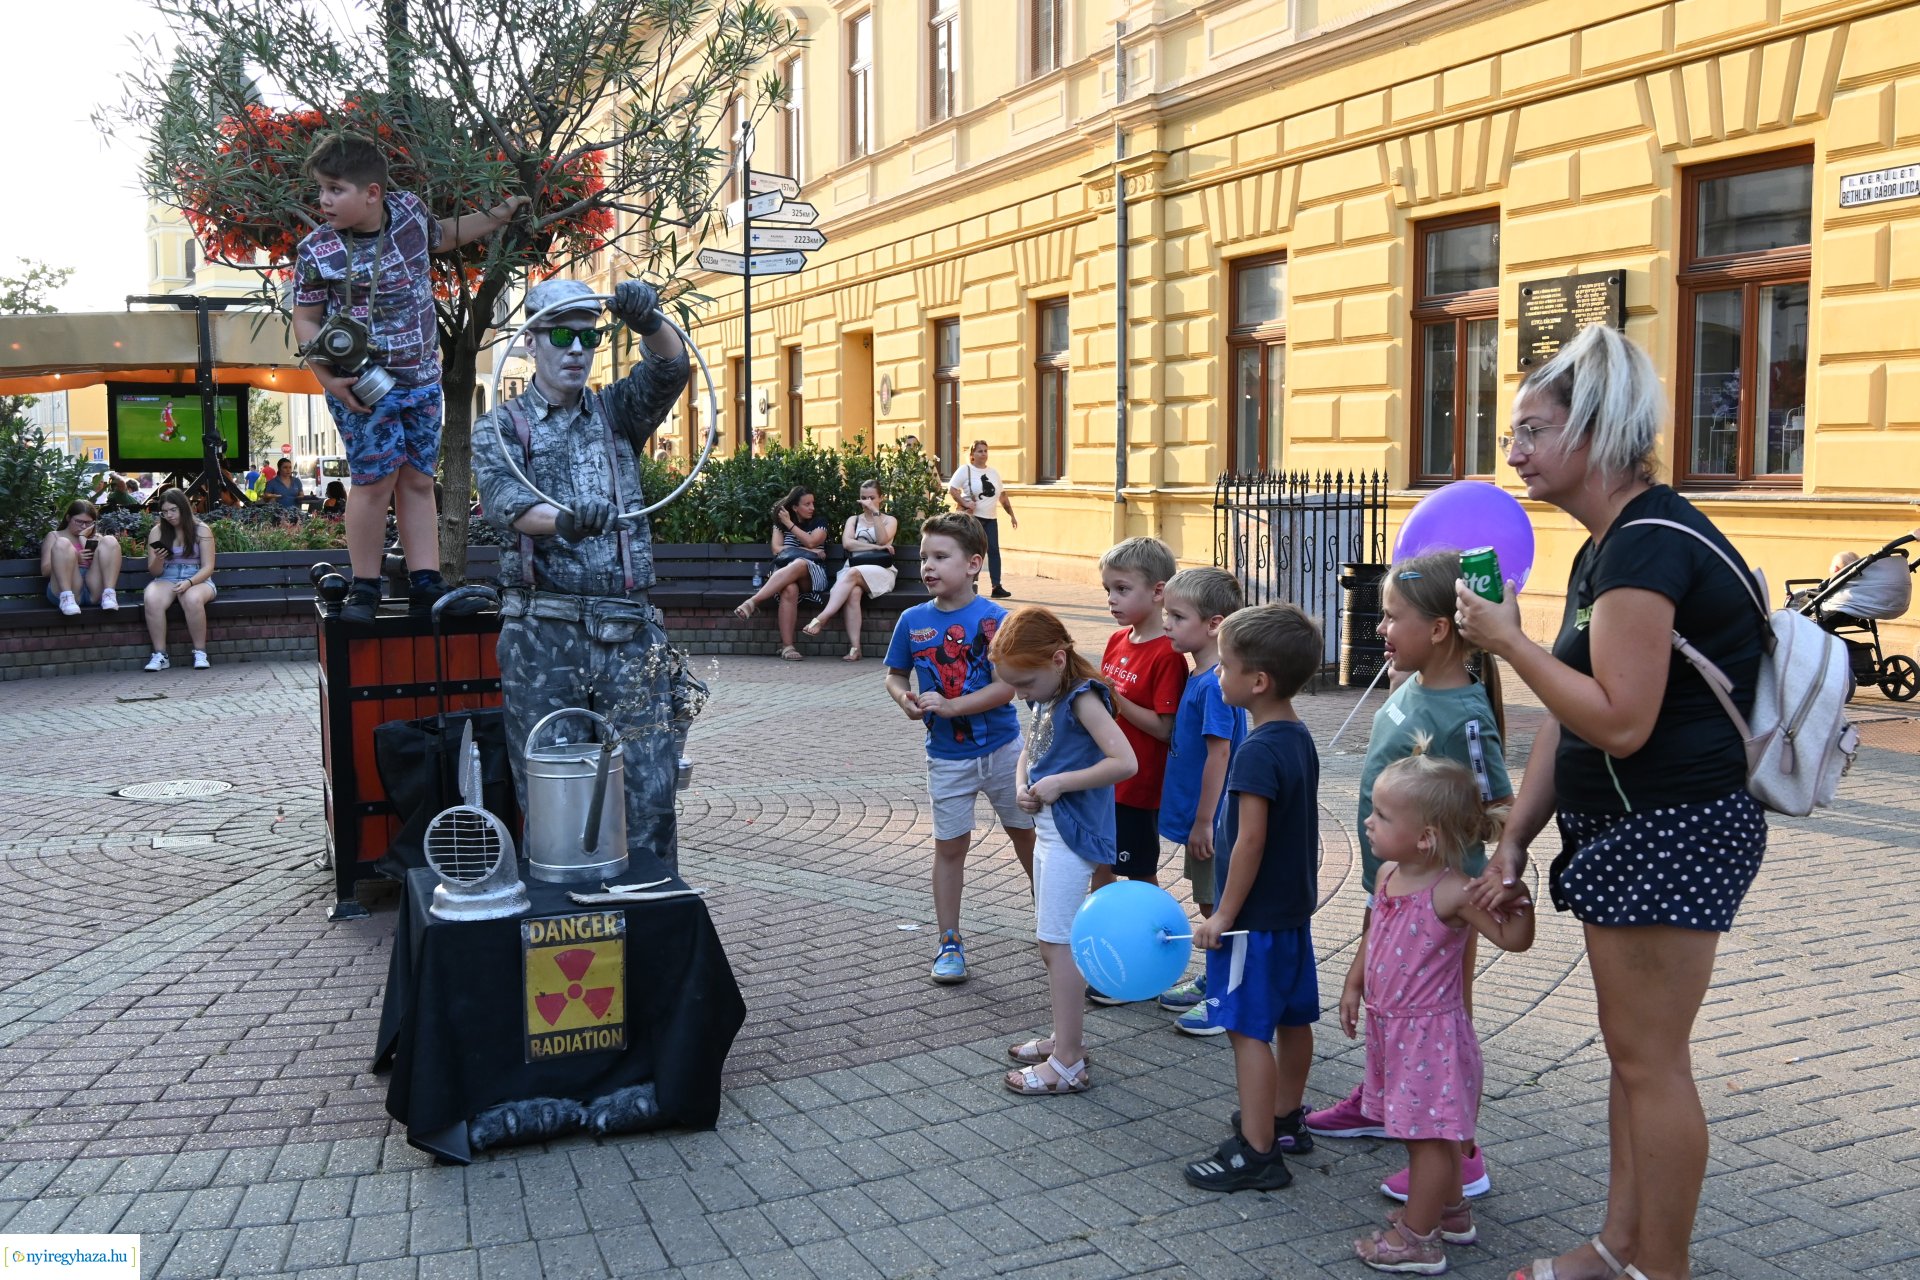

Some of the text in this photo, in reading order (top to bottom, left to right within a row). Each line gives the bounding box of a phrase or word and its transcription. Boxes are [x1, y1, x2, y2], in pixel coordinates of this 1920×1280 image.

[1860, 168, 1913, 185] KERÜLET
[1842, 180, 1920, 204] BETHLEN GÁBOR UTCA
[1463, 571, 1491, 593] ite
[529, 915, 618, 944] DANGER
[531, 1027, 623, 1057] RADIATION
